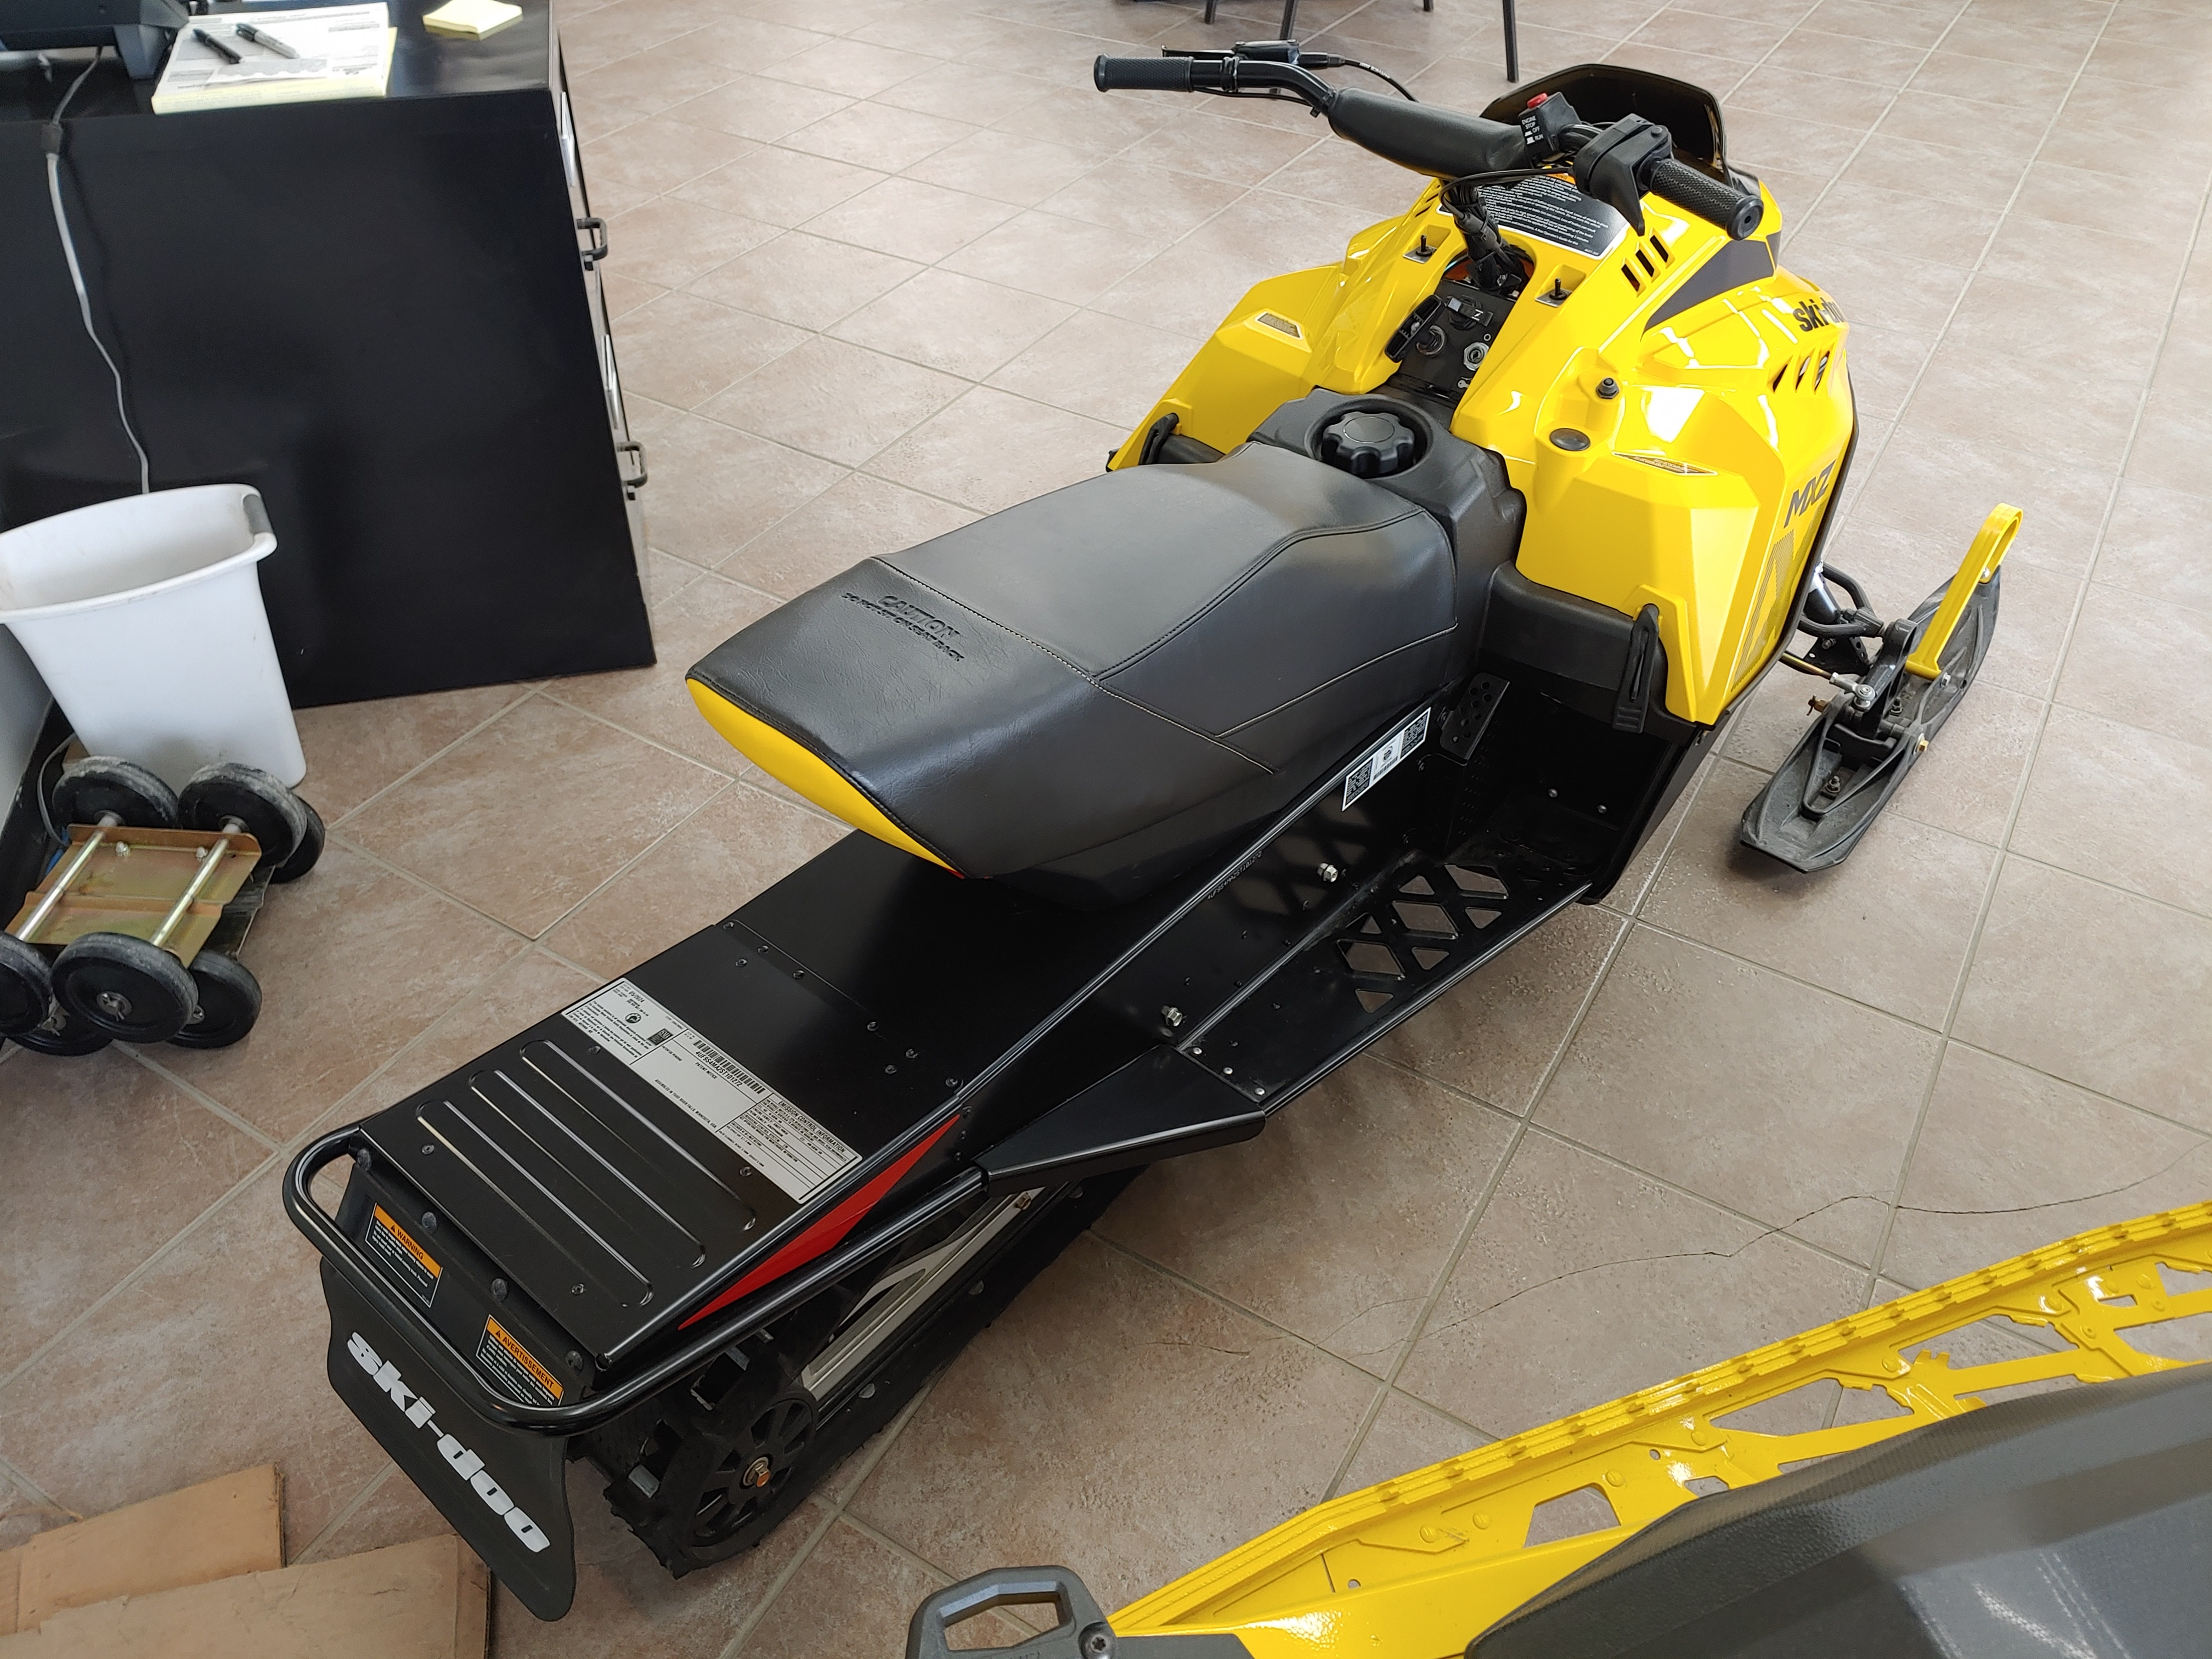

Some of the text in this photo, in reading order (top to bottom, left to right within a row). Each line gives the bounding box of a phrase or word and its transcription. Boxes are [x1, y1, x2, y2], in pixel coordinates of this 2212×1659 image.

[1784, 459, 1837, 529] MXZ
[878, 596, 960, 640] CAUTION
[893, 617, 913, 627] ON
[908, 625, 938, 640] SEAT
[628, 990, 645, 1003] 05/2024
[694, 1050, 743, 1087] 4UF9S4MA2ST101272
[695, 1062, 707, 1071] PATENT
[777, 1101, 799, 1117] EMISSION
[797, 1115, 818, 1131] CONTROL
[815, 1129, 846, 1153] INFORMATION
[397, 1229, 424, 1260] WARNING
[503, 1337, 554, 1388] AVERTISSEMENT
[347, 1331, 550, 1553] ski-doo
